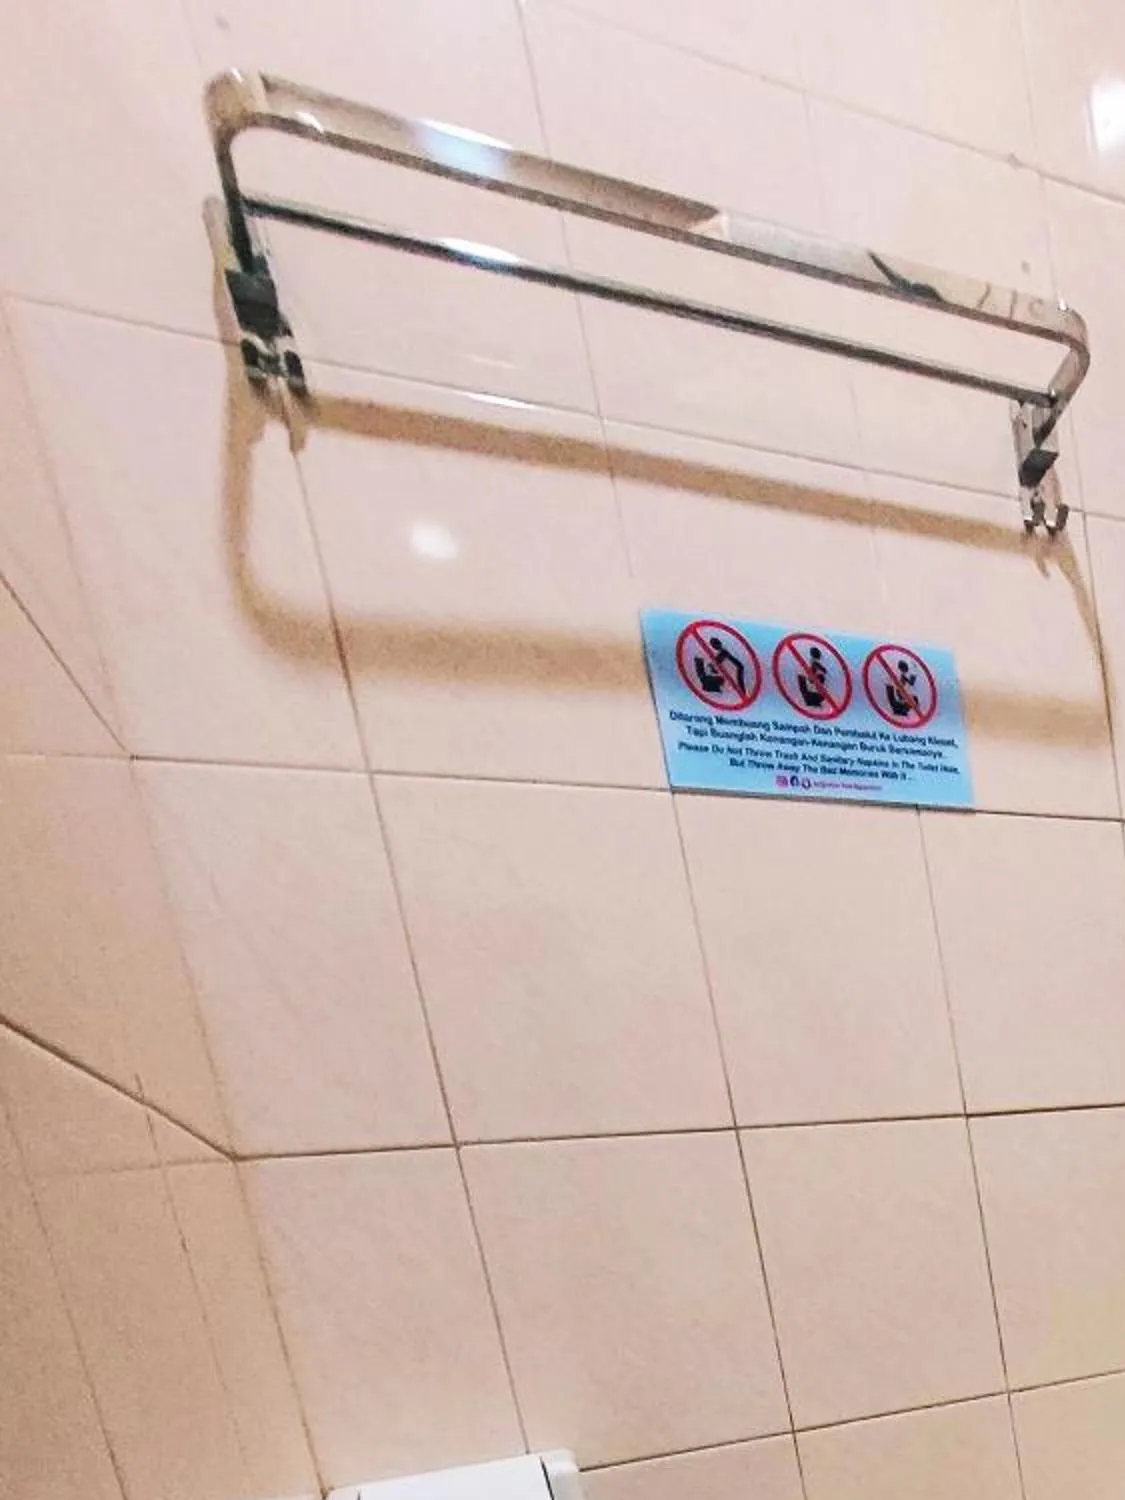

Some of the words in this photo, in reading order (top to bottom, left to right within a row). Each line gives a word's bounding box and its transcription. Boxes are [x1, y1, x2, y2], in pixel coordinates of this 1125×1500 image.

[813, 725, 832, 736] Dan
[679, 742, 709, 752] Please
[775, 750, 798, 760] Trash
[801, 753, 818, 762] And
[730, 758, 744, 768] But
